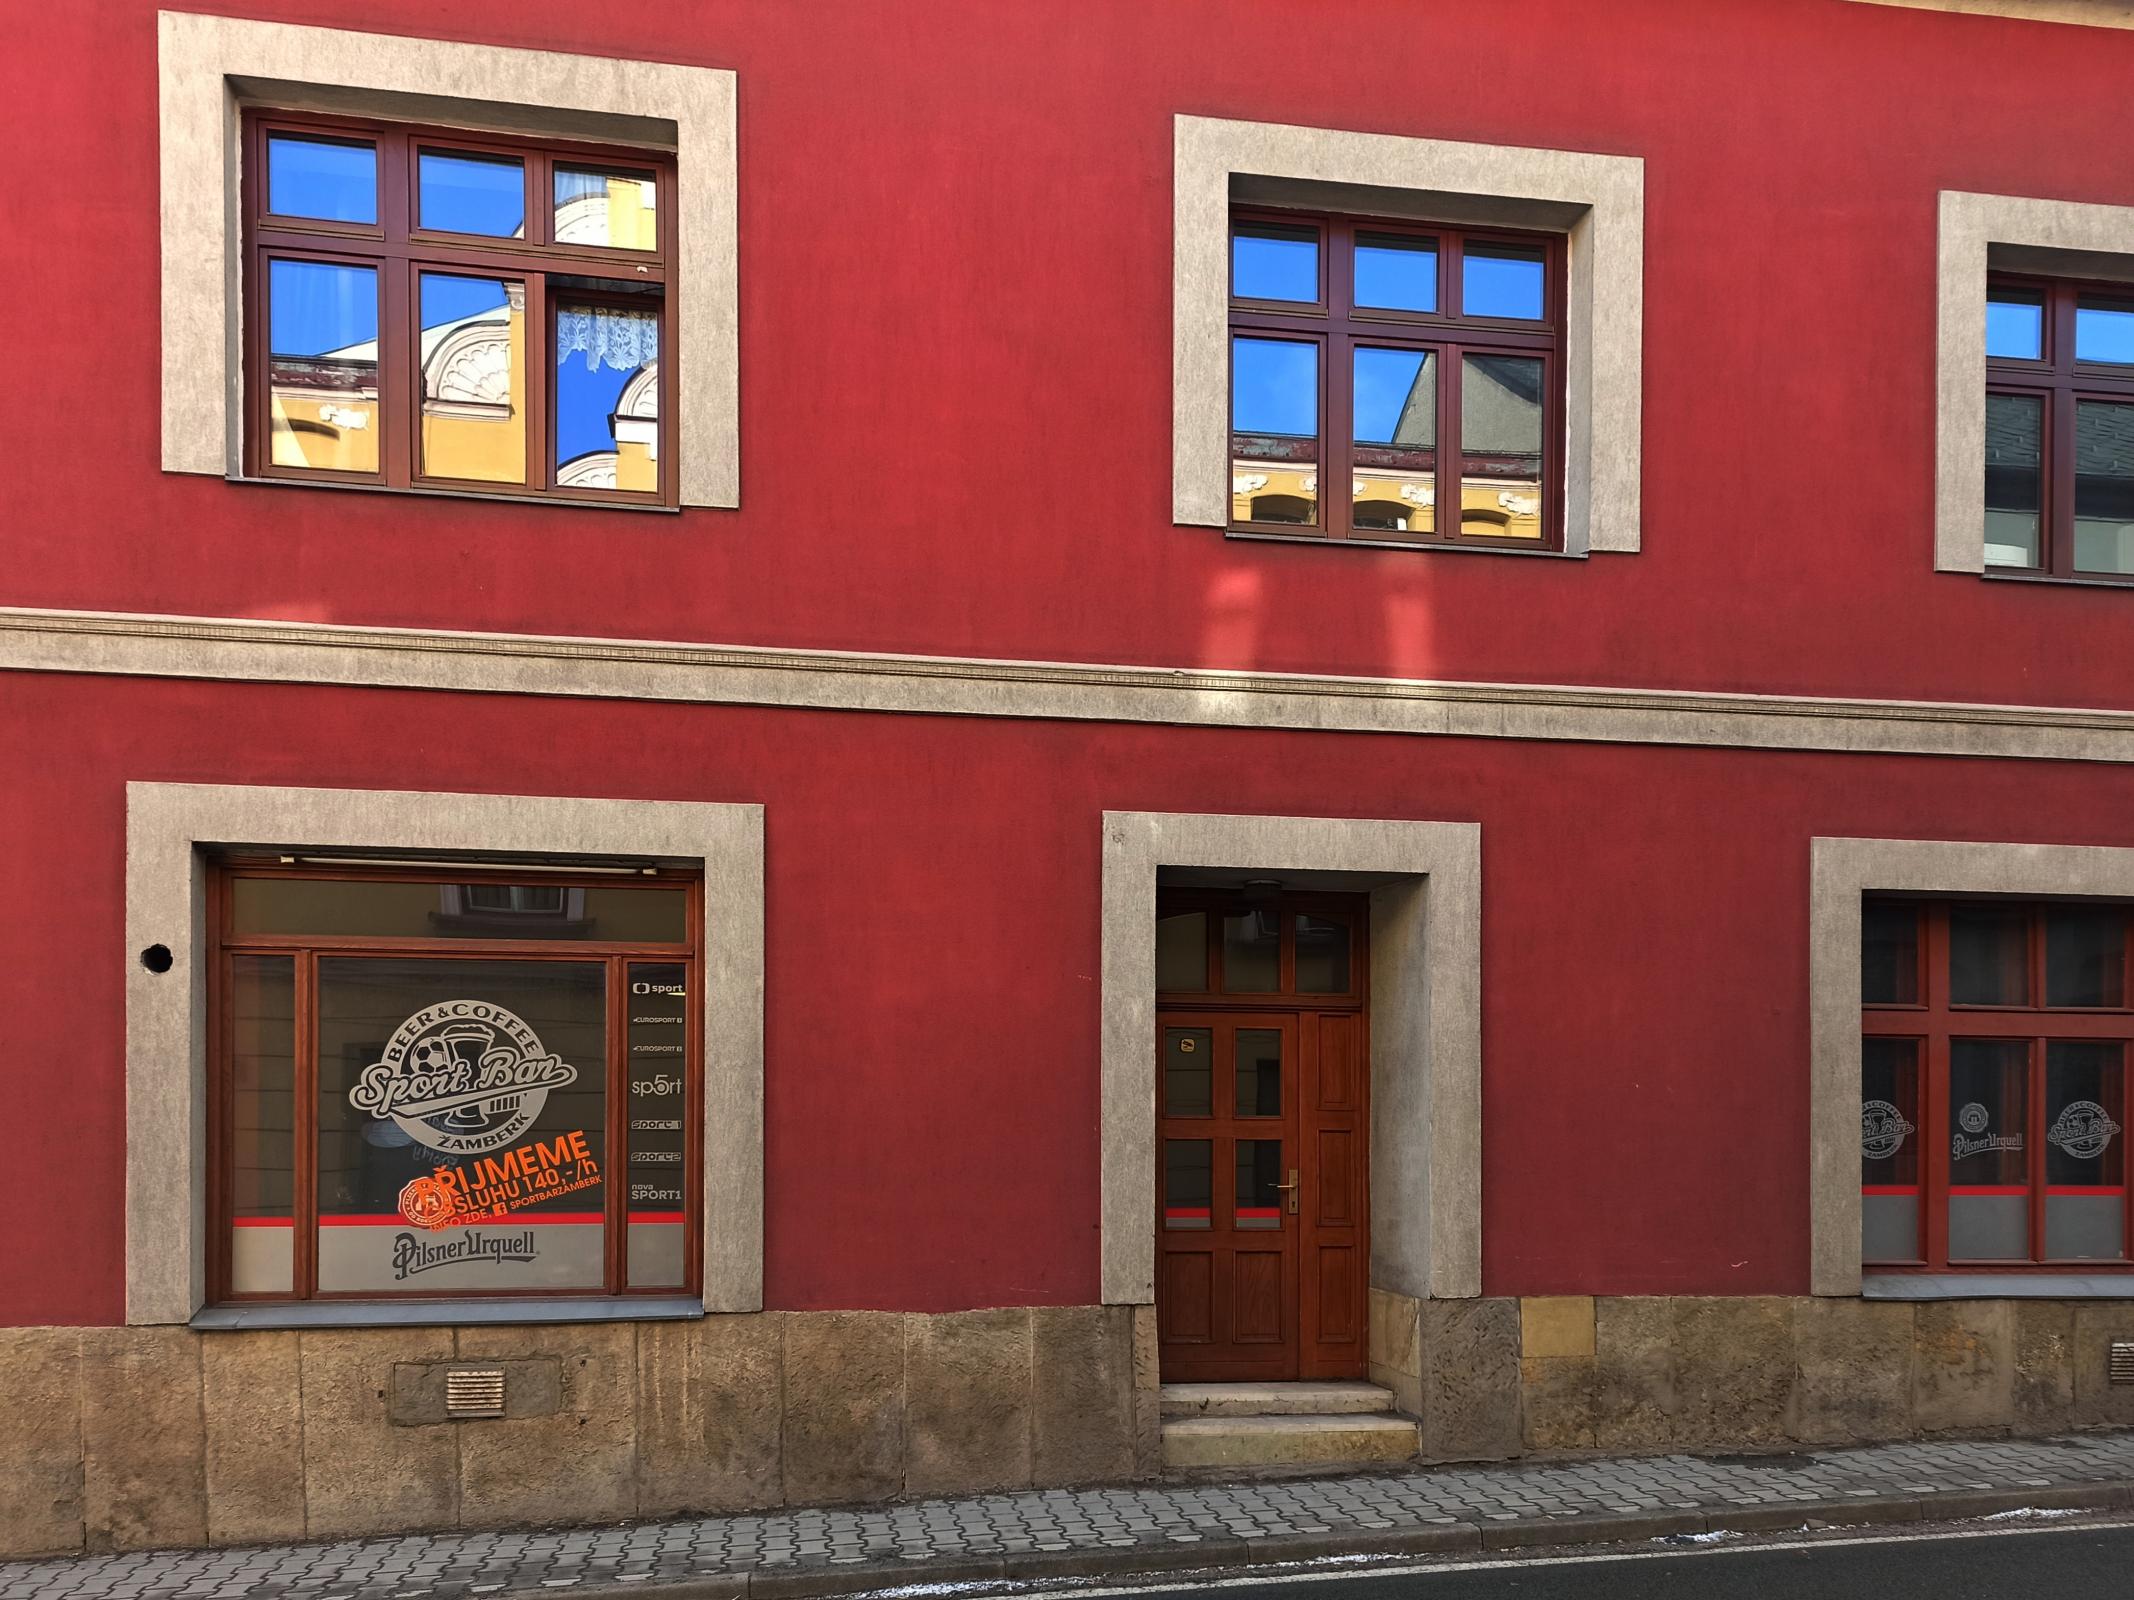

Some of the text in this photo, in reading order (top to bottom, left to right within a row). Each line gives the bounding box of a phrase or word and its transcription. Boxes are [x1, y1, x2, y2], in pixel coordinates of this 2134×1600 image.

[651, 984, 683, 994] sport
[351, 1048, 574, 1117] Sport Bar
[437, 1112, 530, 1150] ŽAMBERK
[1953, 1132, 2024, 1161] Pilsner Urquell
[414, 1130, 591, 1208] PŘIJMEME
[631, 1190, 682, 1200] SPORT1
[392, 1229, 535, 1280] Pilsner Urquell
